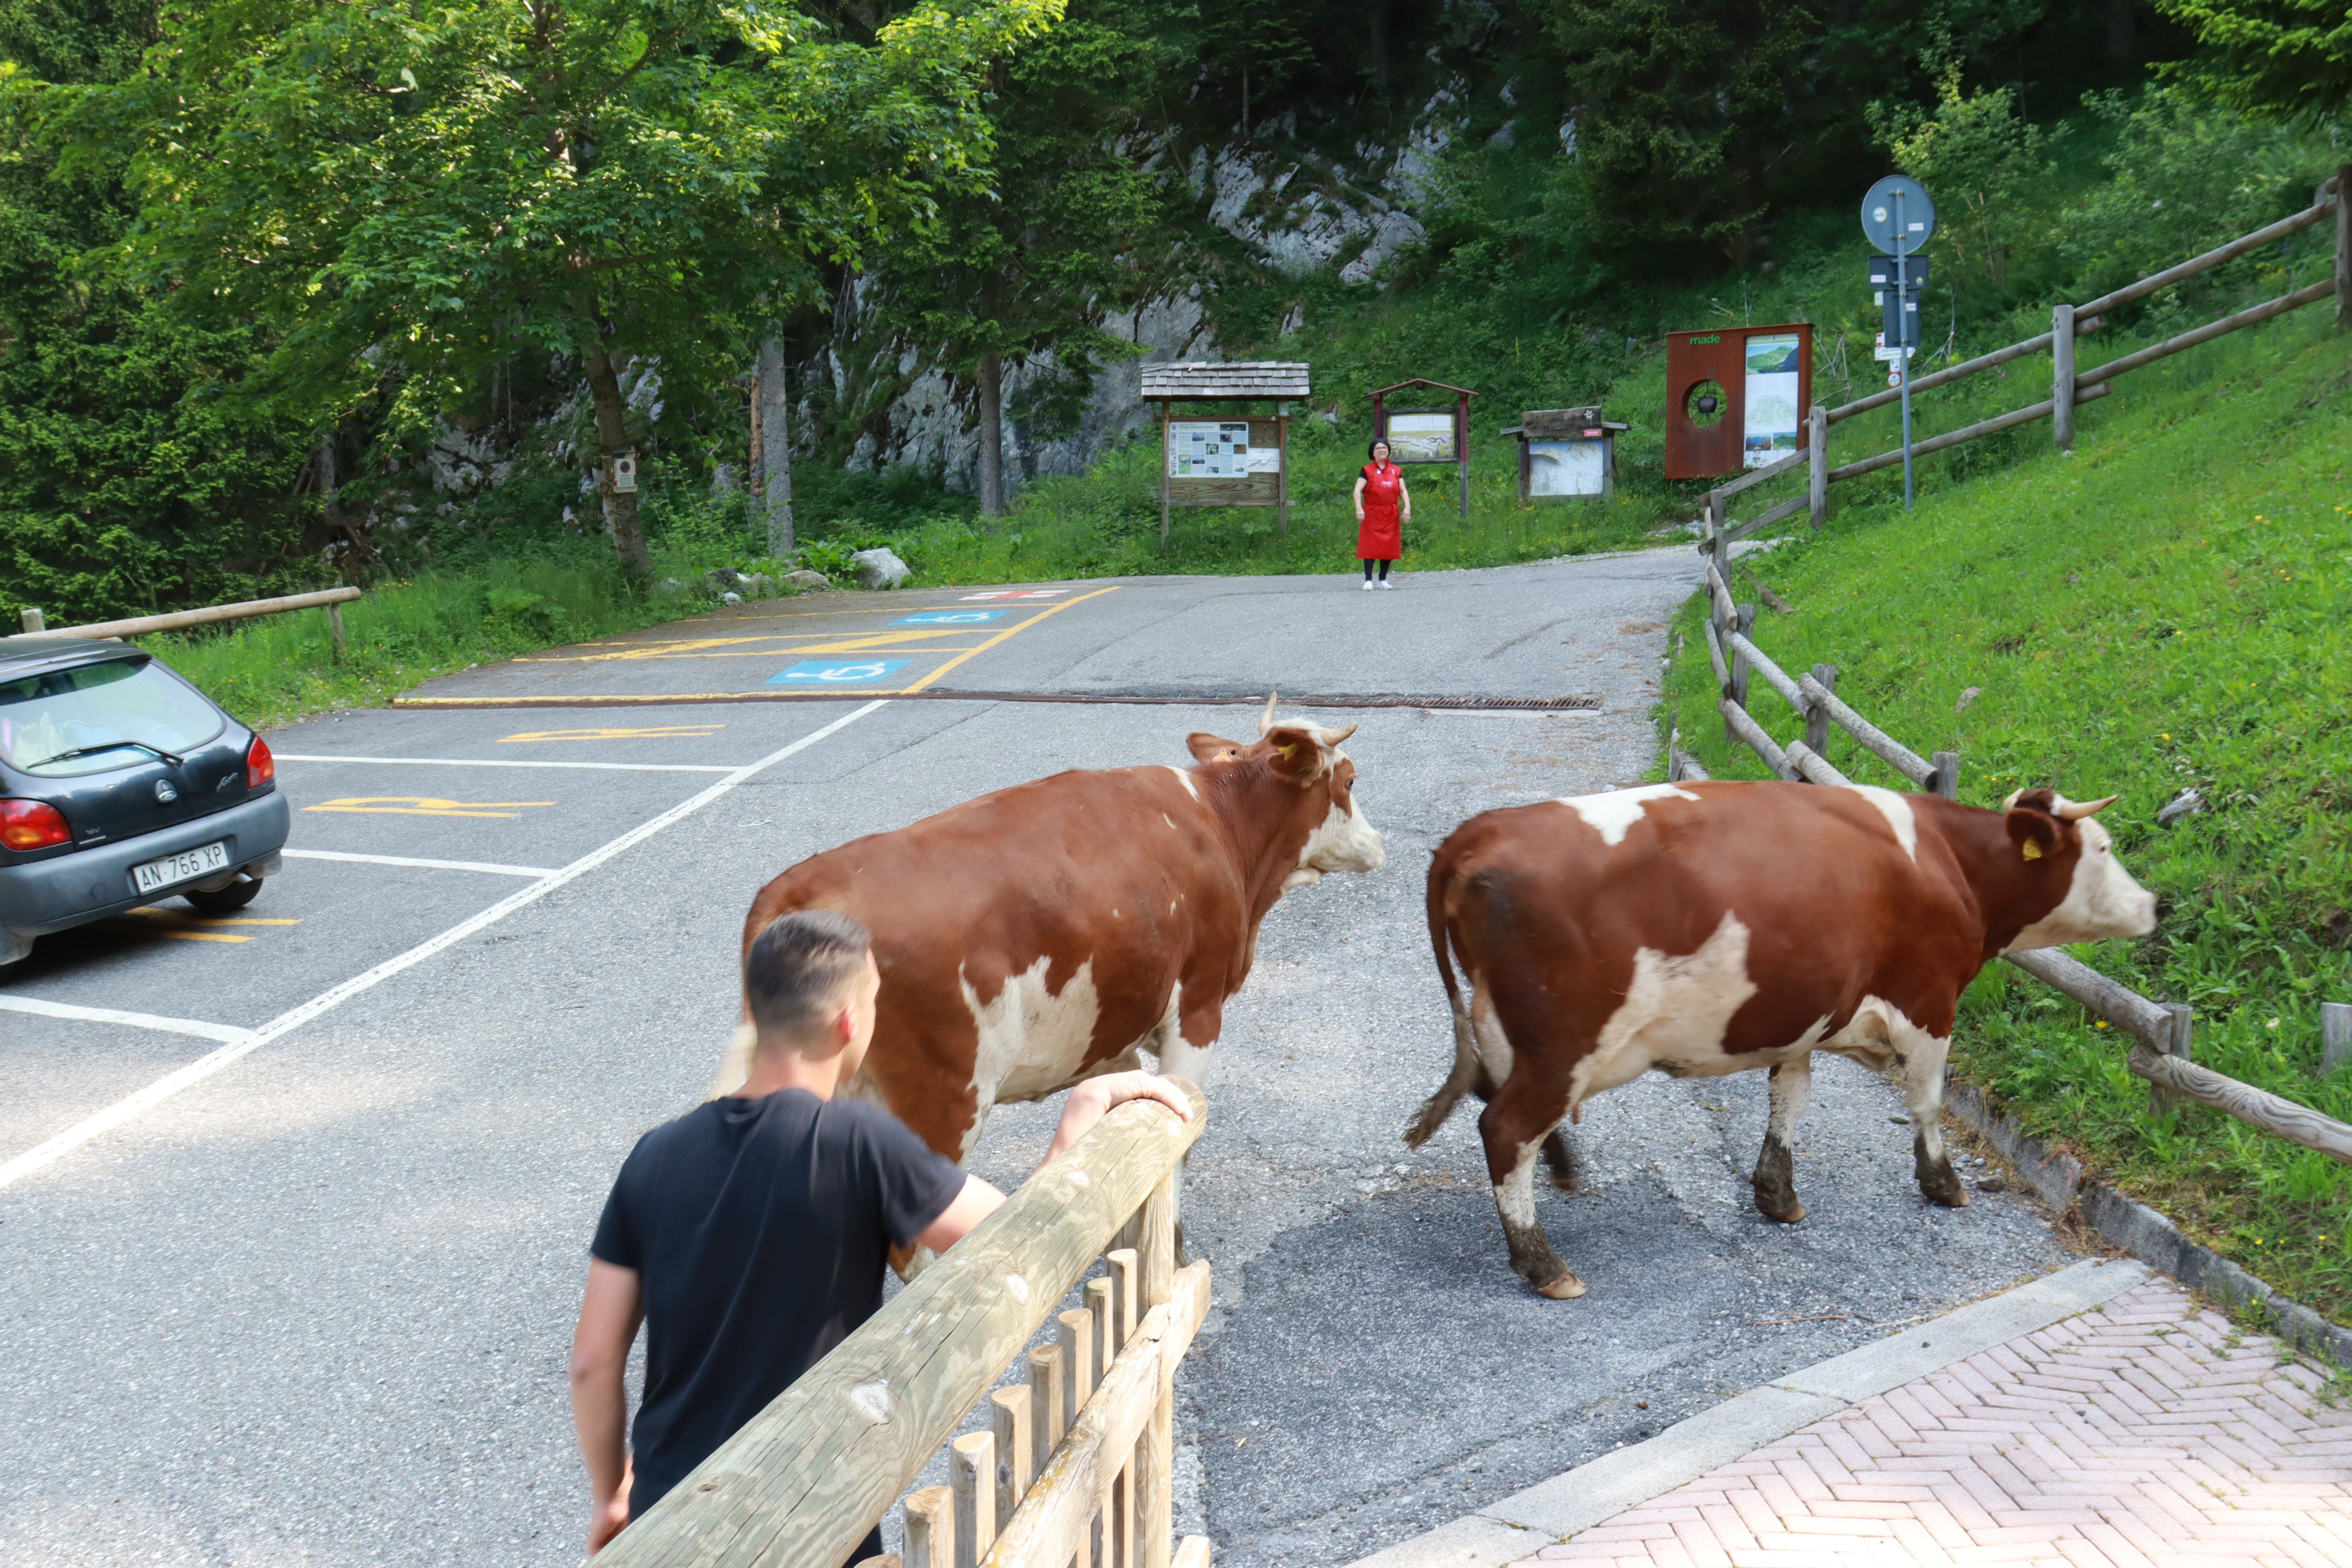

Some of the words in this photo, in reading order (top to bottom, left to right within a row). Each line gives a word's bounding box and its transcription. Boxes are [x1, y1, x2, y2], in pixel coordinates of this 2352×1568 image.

[1690, 334, 1720, 345] made
[142, 864, 162, 888] AN
[168, 853, 200, 879] 766
[203, 846, 221, 868] XP
